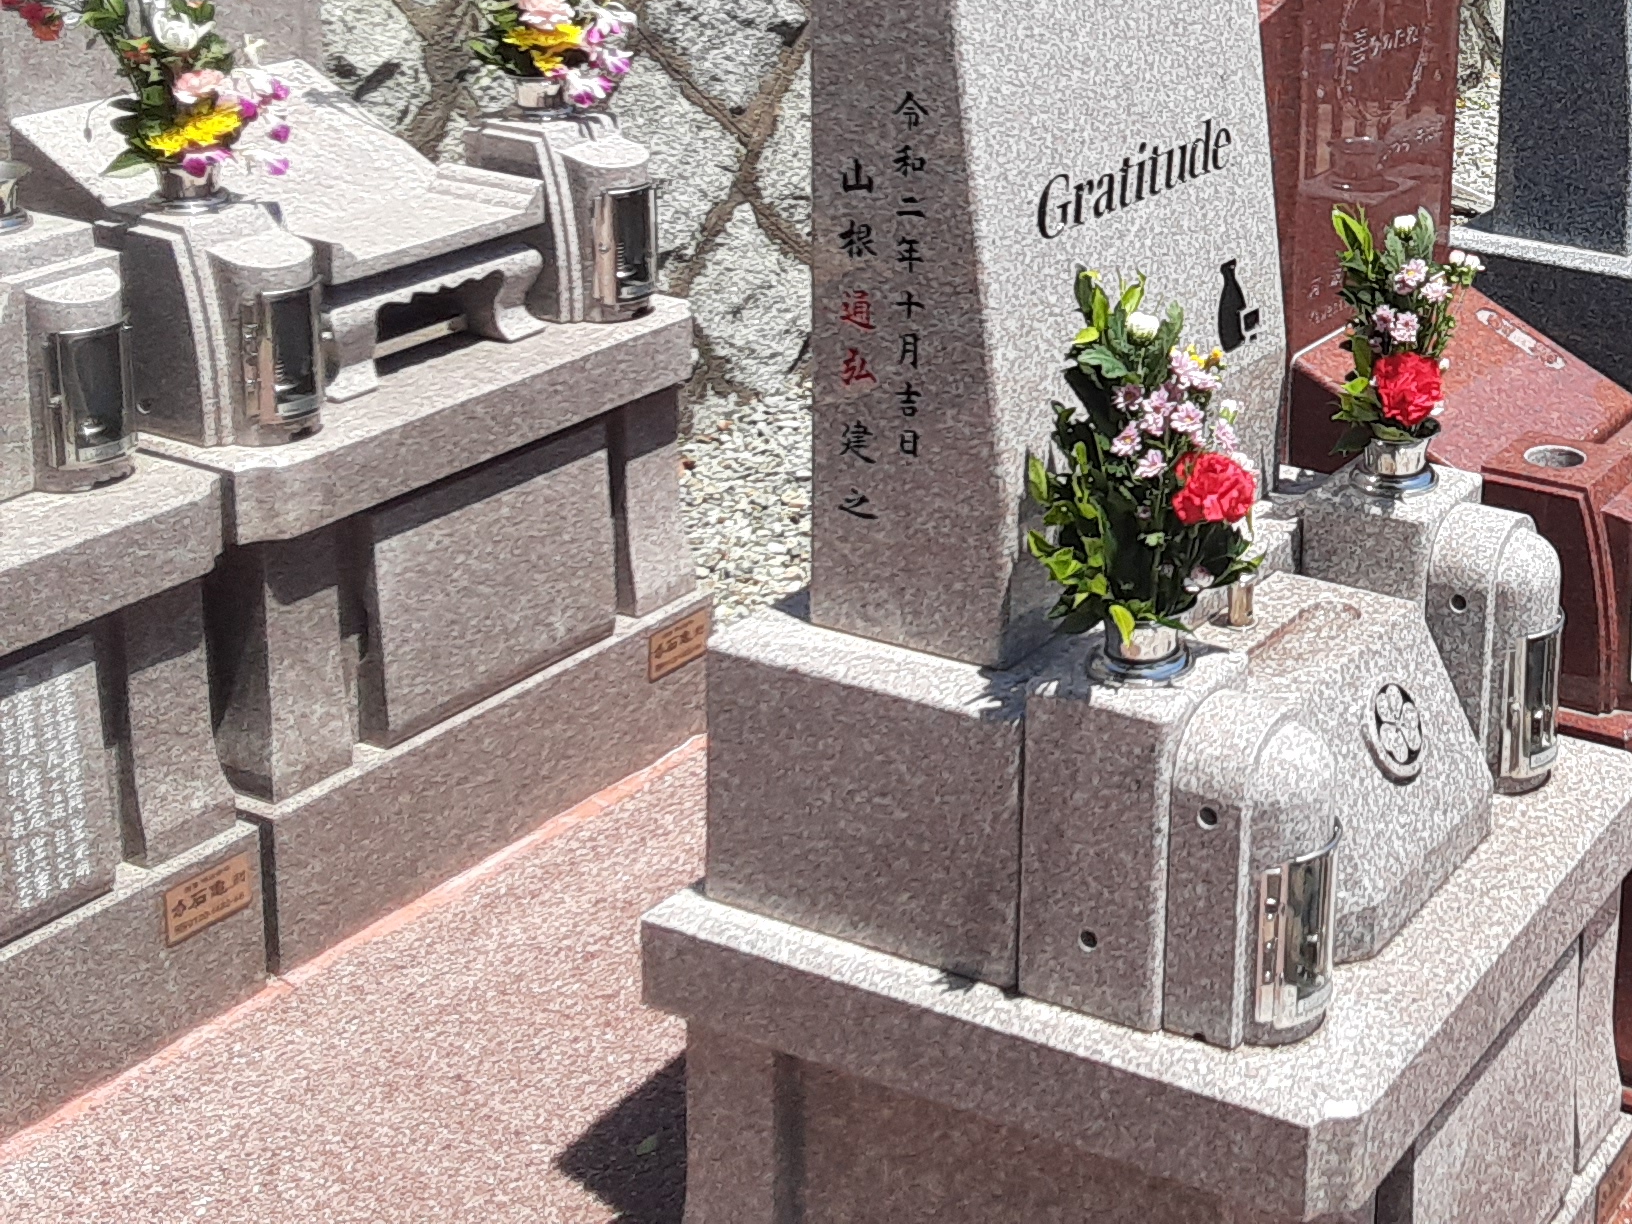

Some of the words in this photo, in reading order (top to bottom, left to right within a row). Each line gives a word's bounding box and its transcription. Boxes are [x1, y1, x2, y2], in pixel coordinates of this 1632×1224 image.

[893, 91, 930, 458] 令和二年十月吉日
[1036, 118, 1232, 240] Gratitude
